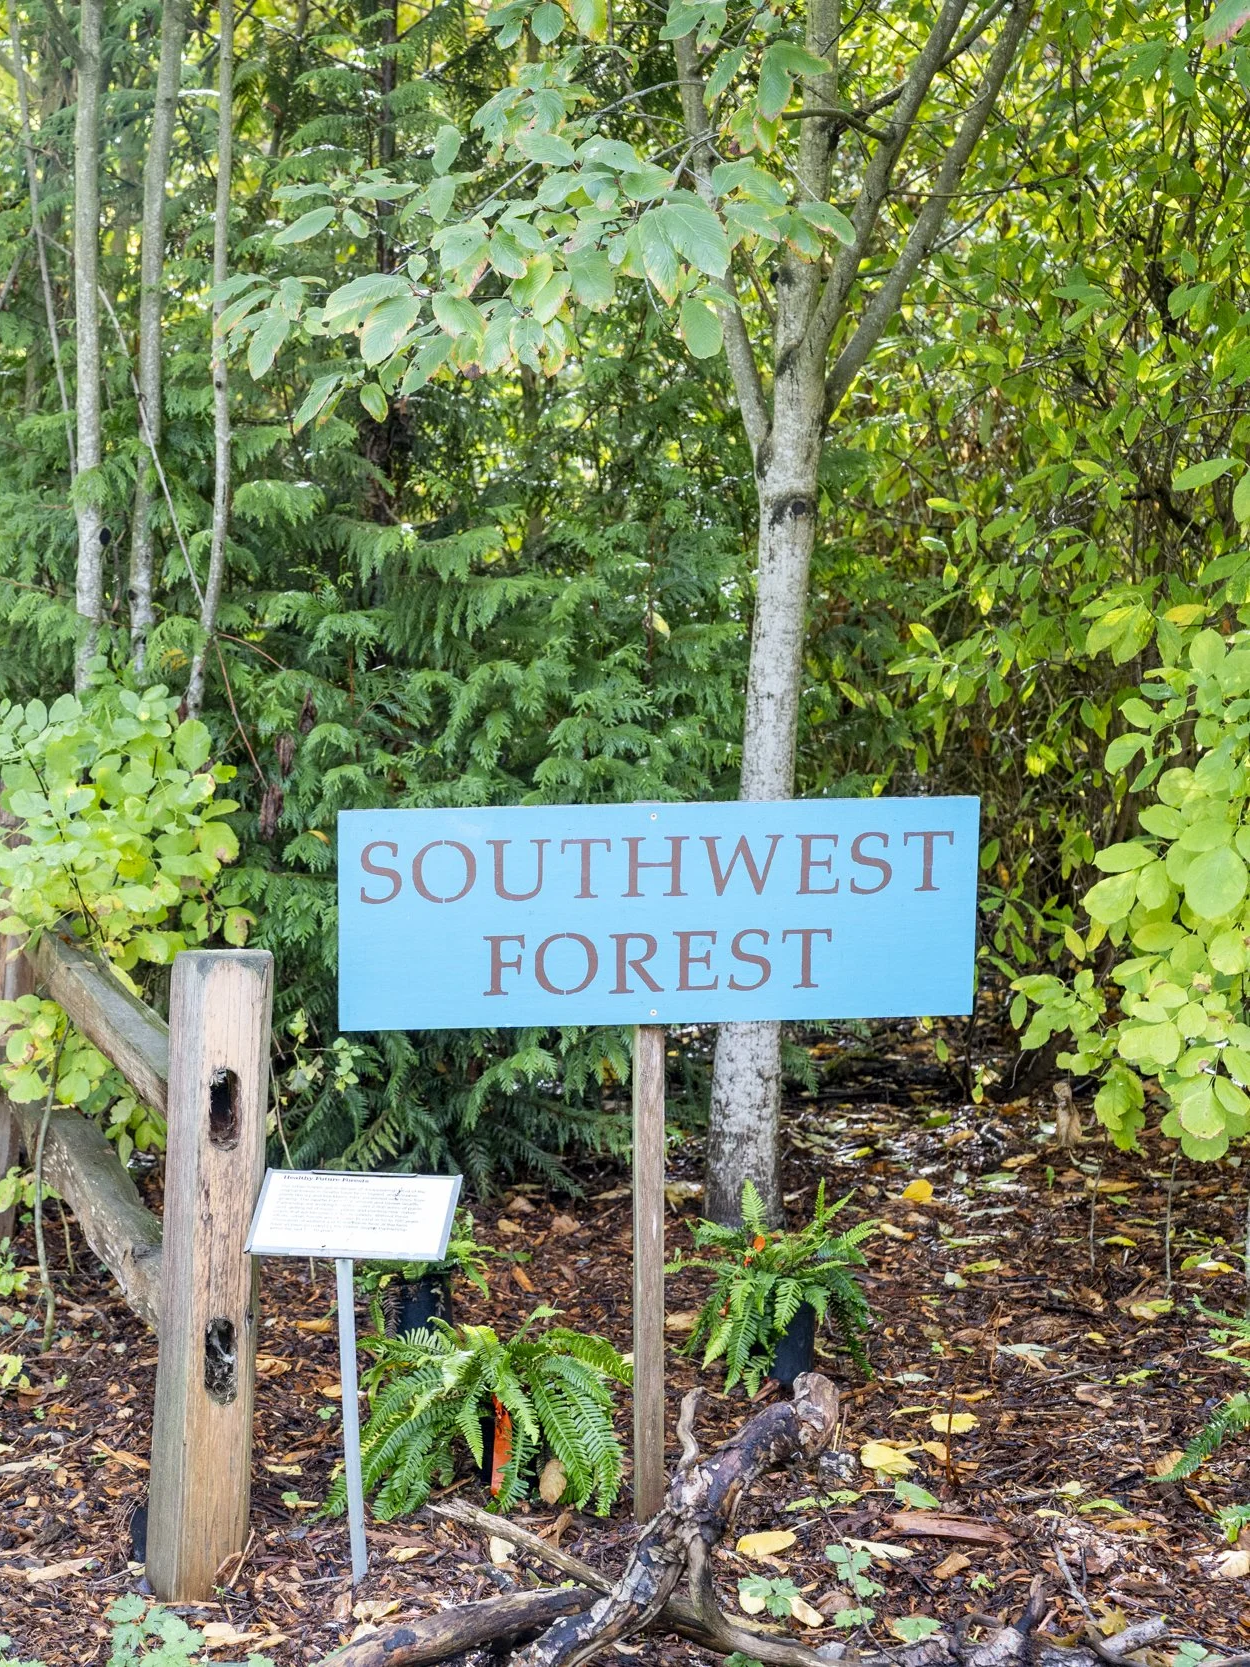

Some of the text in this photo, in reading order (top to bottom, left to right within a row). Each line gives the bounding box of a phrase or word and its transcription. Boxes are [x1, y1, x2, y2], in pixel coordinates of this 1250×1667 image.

[359, 830, 955, 905] SOUTHWEST
[482, 928, 833, 997] FOREST
[283, 1174, 314, 1182] Healthy
